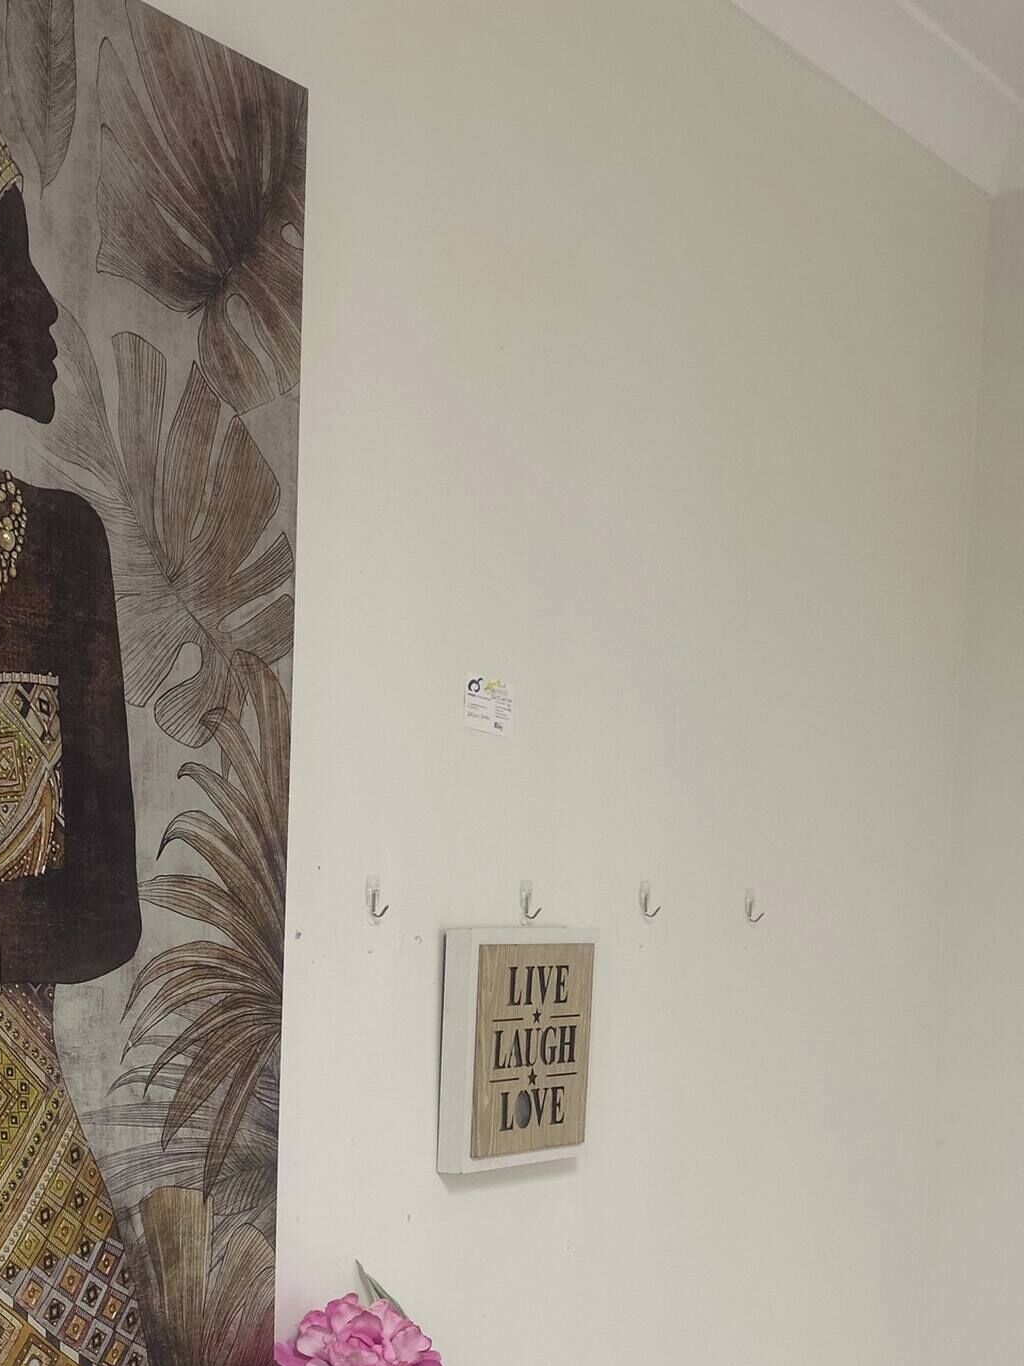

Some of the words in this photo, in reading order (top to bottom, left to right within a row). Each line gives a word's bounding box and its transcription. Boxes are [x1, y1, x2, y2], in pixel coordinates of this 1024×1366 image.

[507, 965, 569, 1006] LIVE
[493, 1025, 577, 1070] LAUGH
[499, 1086, 565, 1132] LOVE
